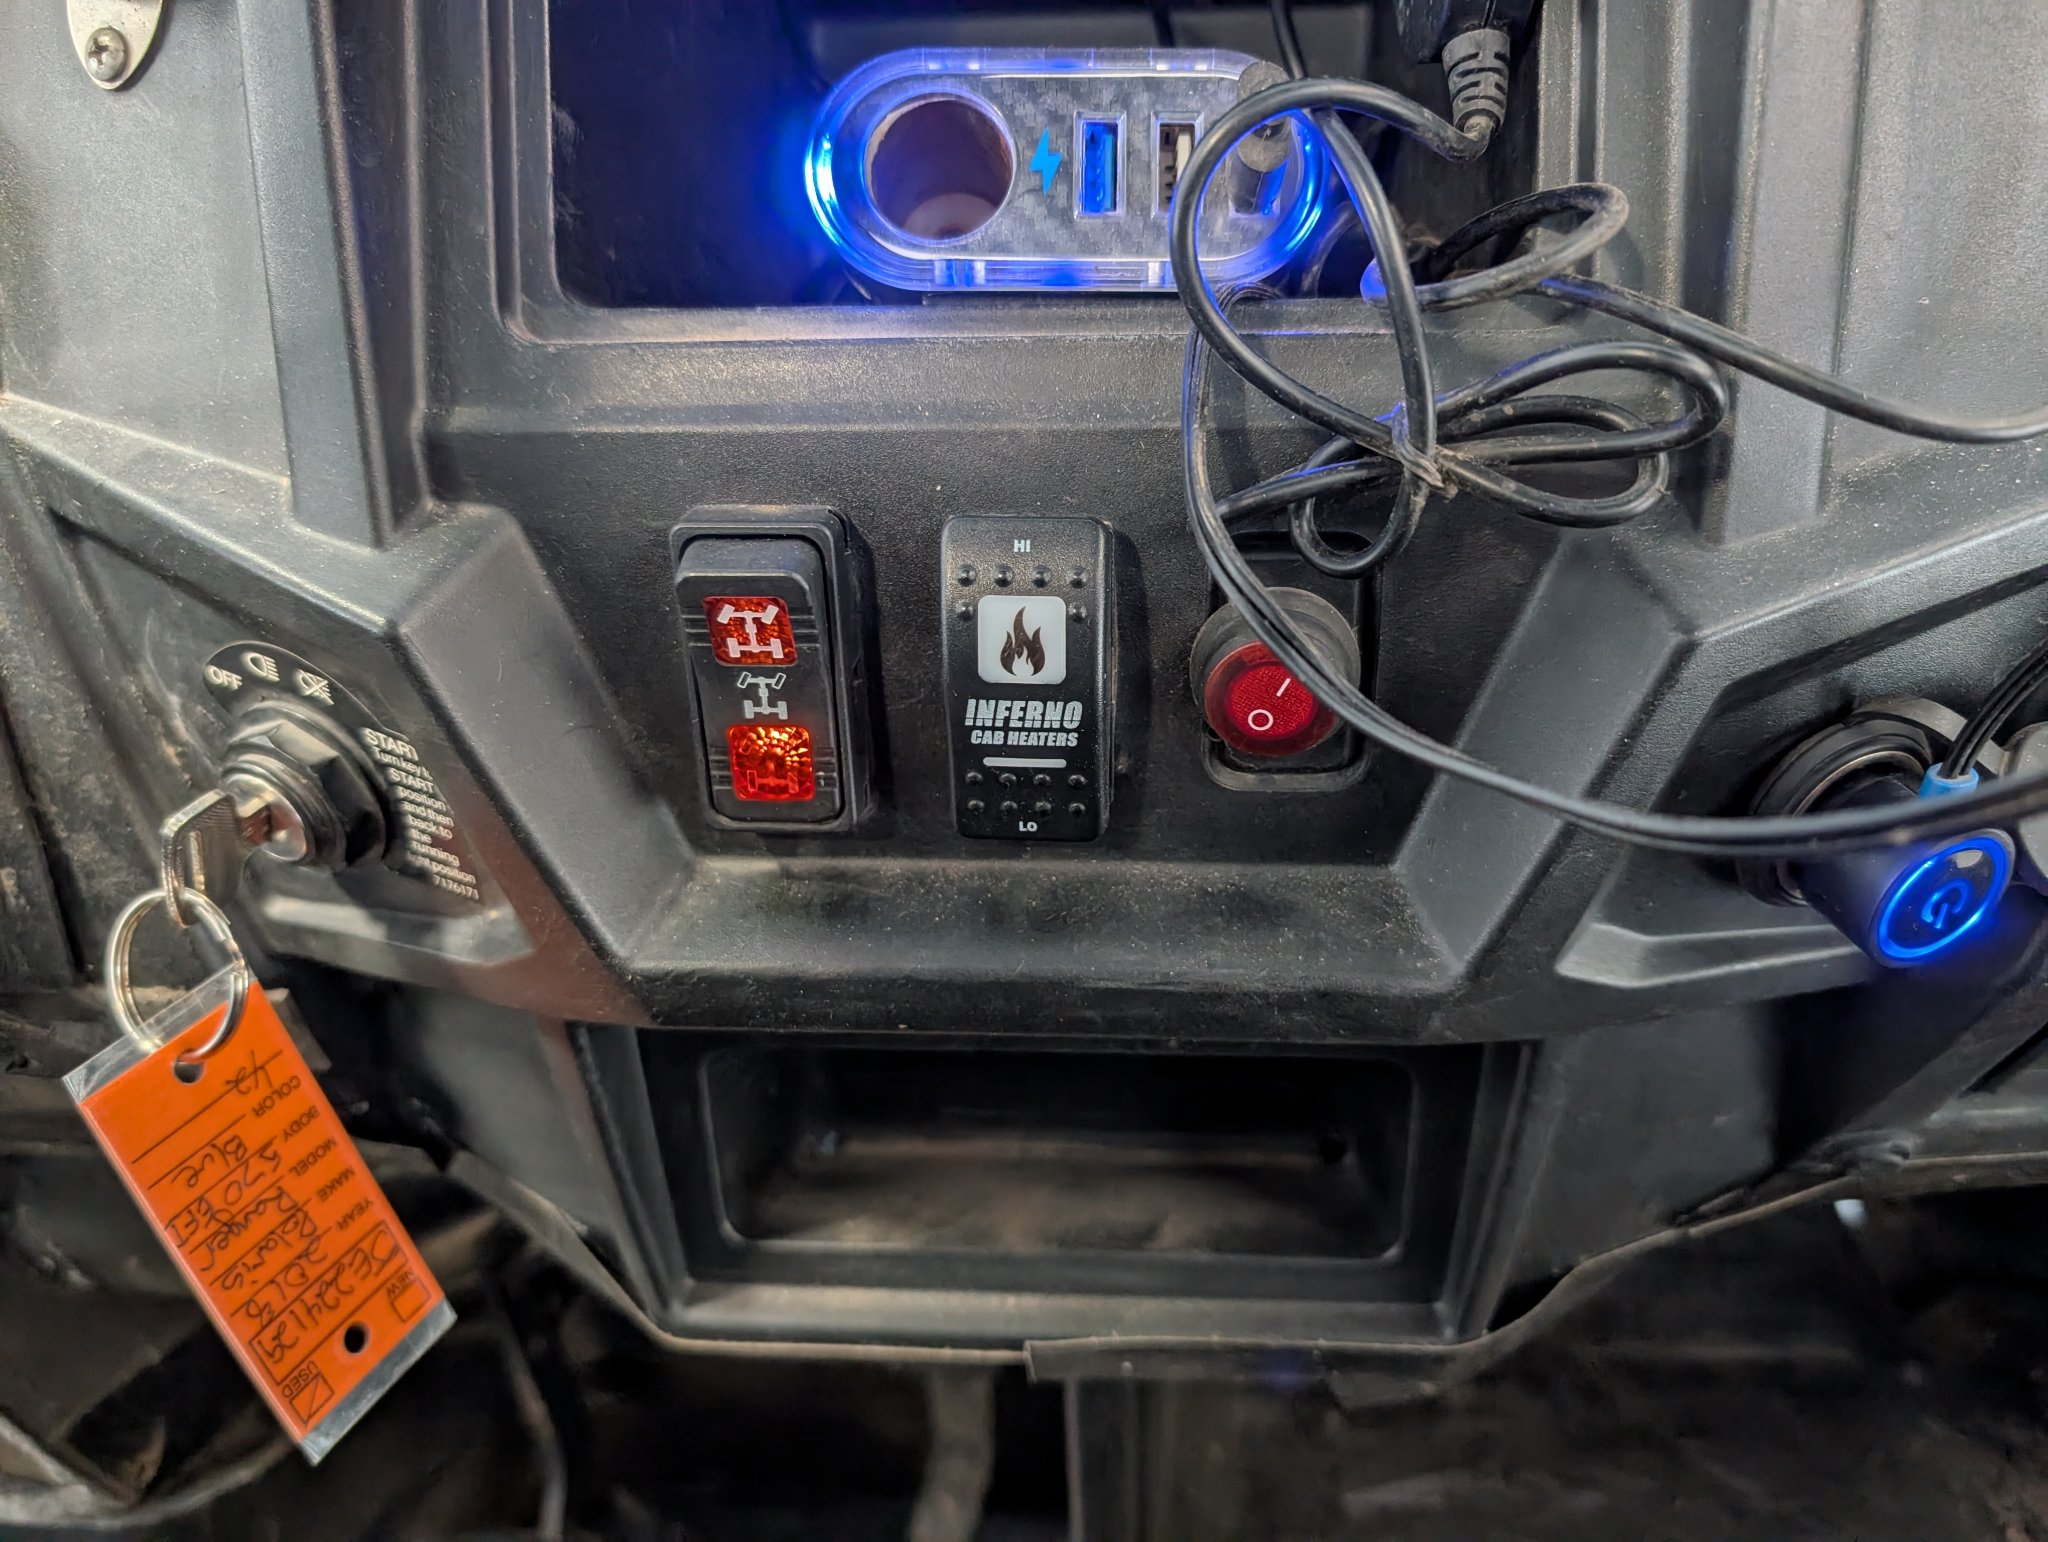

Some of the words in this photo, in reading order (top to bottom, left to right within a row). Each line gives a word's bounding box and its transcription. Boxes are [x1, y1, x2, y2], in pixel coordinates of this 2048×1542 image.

[1013, 538, 1031, 553] HI
[204, 664, 243, 691] OFF
[964, 698, 1083, 729] INFERNO
[364, 727, 419, 762] START
[970, 729, 1005, 745] CAB
[1006, 730, 1079, 747] HEATERS
[371, 746, 401, 767] Turn
[400, 757, 421, 778] key
[388, 767, 435, 795] START
[397, 786, 447, 812] position
[401, 801, 427, 817] and
[426, 807, 455, 828] then
[407, 814, 435, 835] back
[435, 825, 453, 840] to
[409, 828, 433, 845] the
[1018, 820, 1038, 832] LO
[409, 840, 460, 869] running
[430, 861, 477, 887] position
[252, 1075, 301, 1117] COLOR
[282, 1105, 320, 1142] BODY
[171, 1135, 247, 1188] Blue
[224, 1139, 282, 1206] 570
[289, 1136, 338, 1177] MODEL
[317, 1165, 356, 1203] MAKE
[201, 1186, 300, 1272] Ranger
[336, 1197, 372, 1231] YEAR
[221, 1207, 318, 1290] Polaris
[386, 1267, 416, 1299] NEW
[281, 1360, 320, 1399] USED
